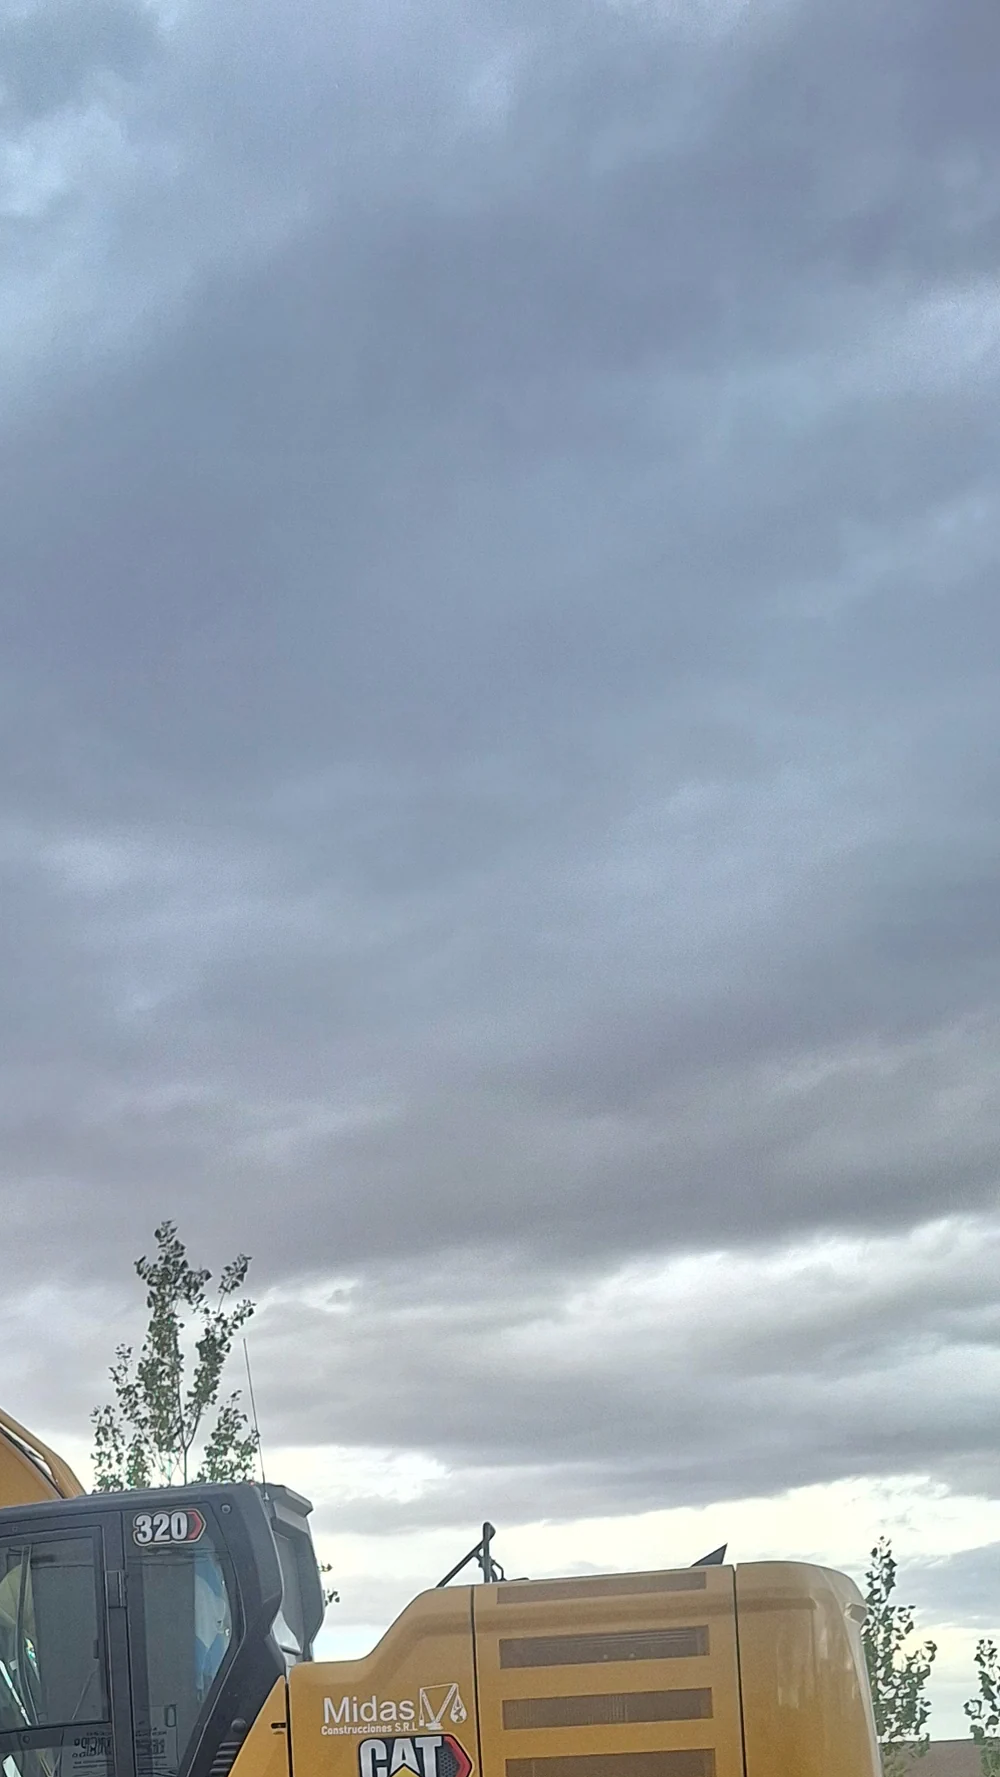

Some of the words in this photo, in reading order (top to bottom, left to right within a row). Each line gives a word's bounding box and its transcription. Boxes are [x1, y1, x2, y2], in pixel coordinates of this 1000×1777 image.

[135, 1511, 188, 1543] 320
[323, 1695, 415, 1724] Midas
[320, 1723, 392, 1735] Construcciones
